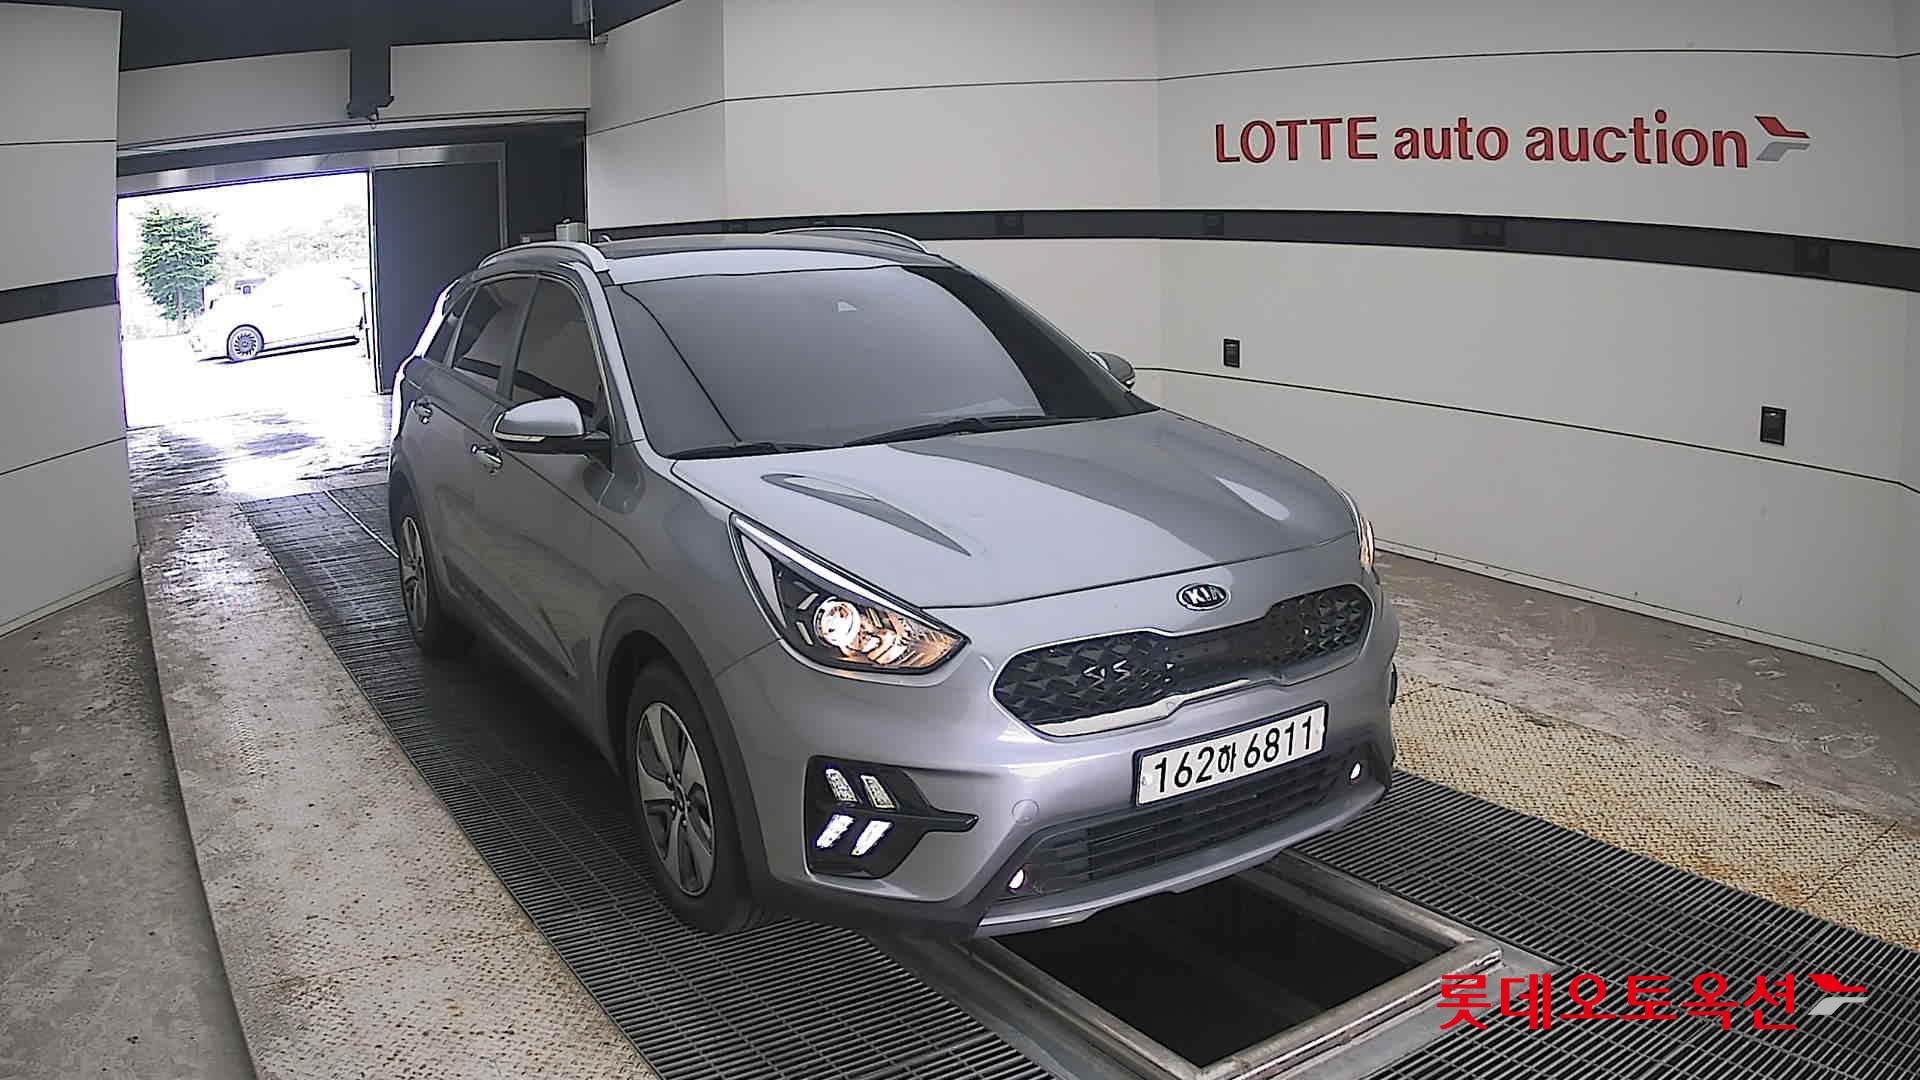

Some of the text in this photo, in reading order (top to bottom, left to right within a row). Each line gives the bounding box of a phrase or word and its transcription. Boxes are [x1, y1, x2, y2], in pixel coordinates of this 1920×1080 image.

[1214, 109, 1749, 169] LOTTE auto auction
[1183, 585, 1225, 605] KIA
